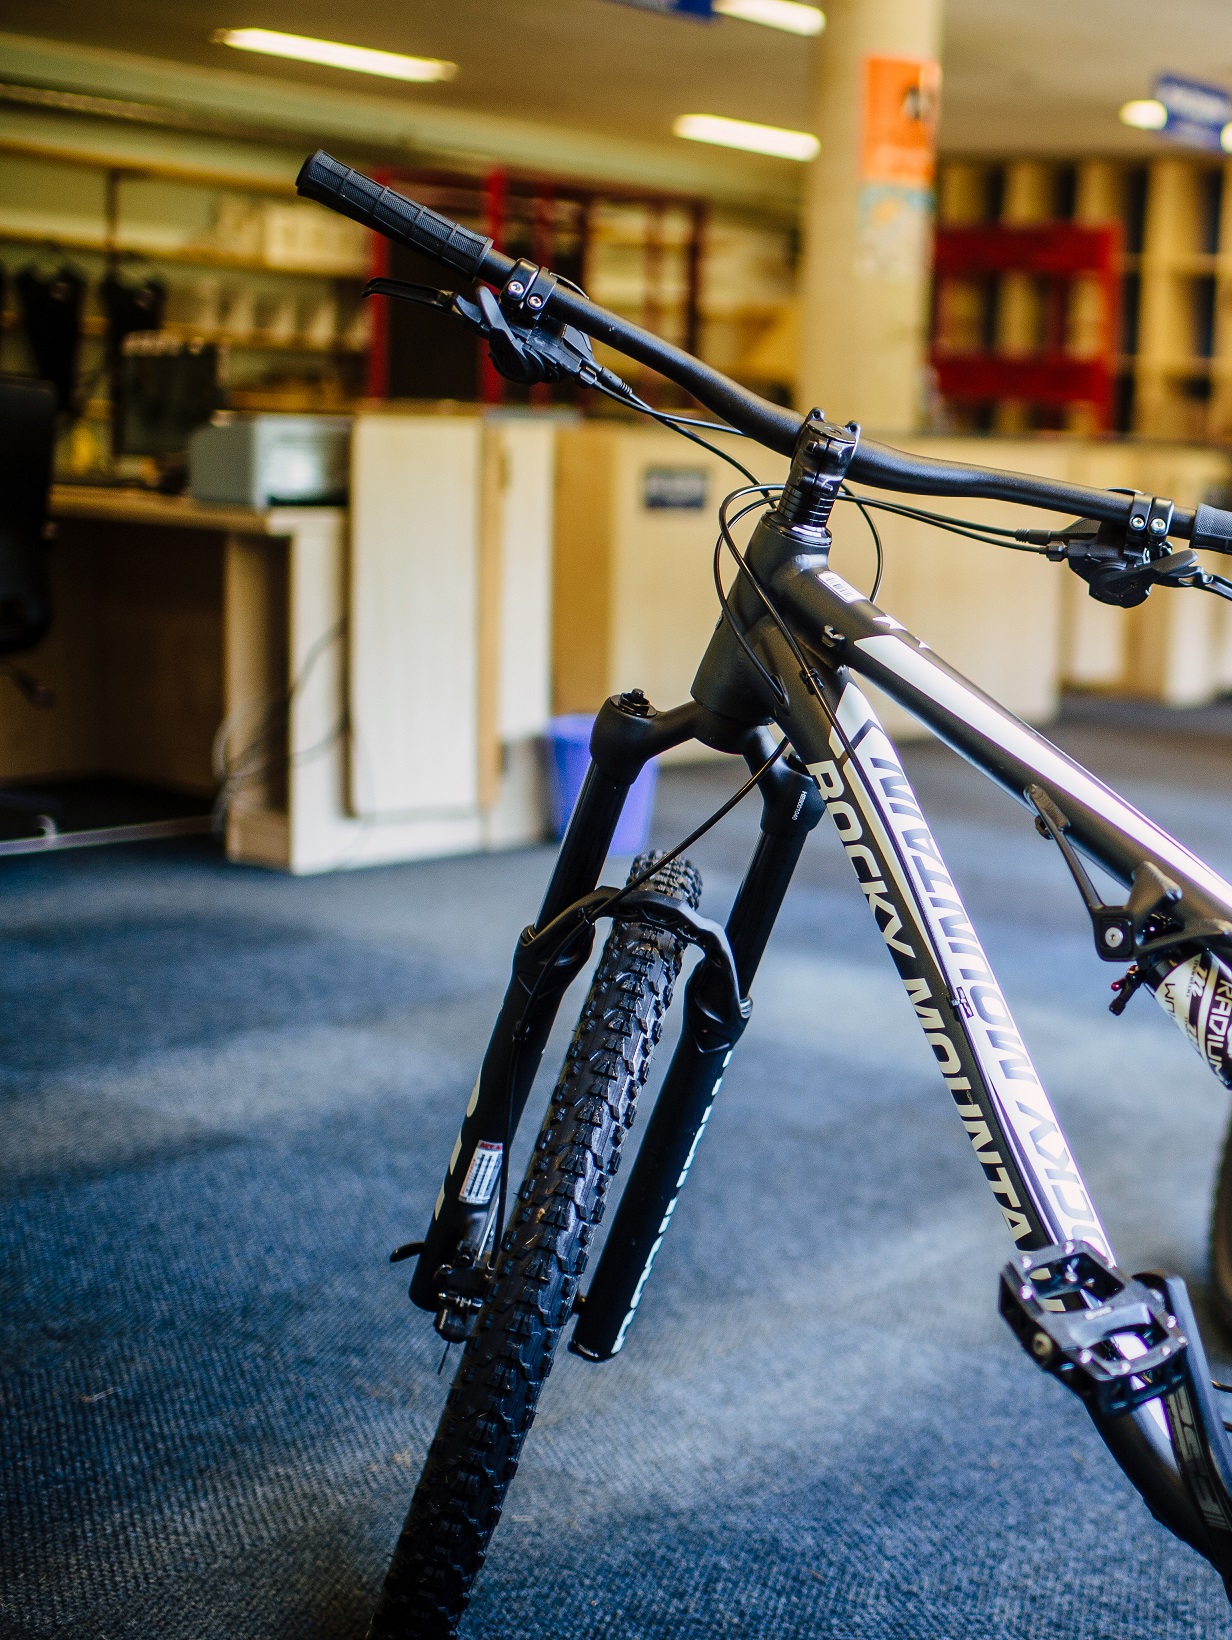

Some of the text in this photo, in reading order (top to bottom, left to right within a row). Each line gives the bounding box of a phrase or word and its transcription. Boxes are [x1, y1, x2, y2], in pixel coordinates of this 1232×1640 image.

[806, 761, 1066, 1313] ROCKY MOUNTA
[867, 756, 1104, 1252] OCKY MOUNTAIN
